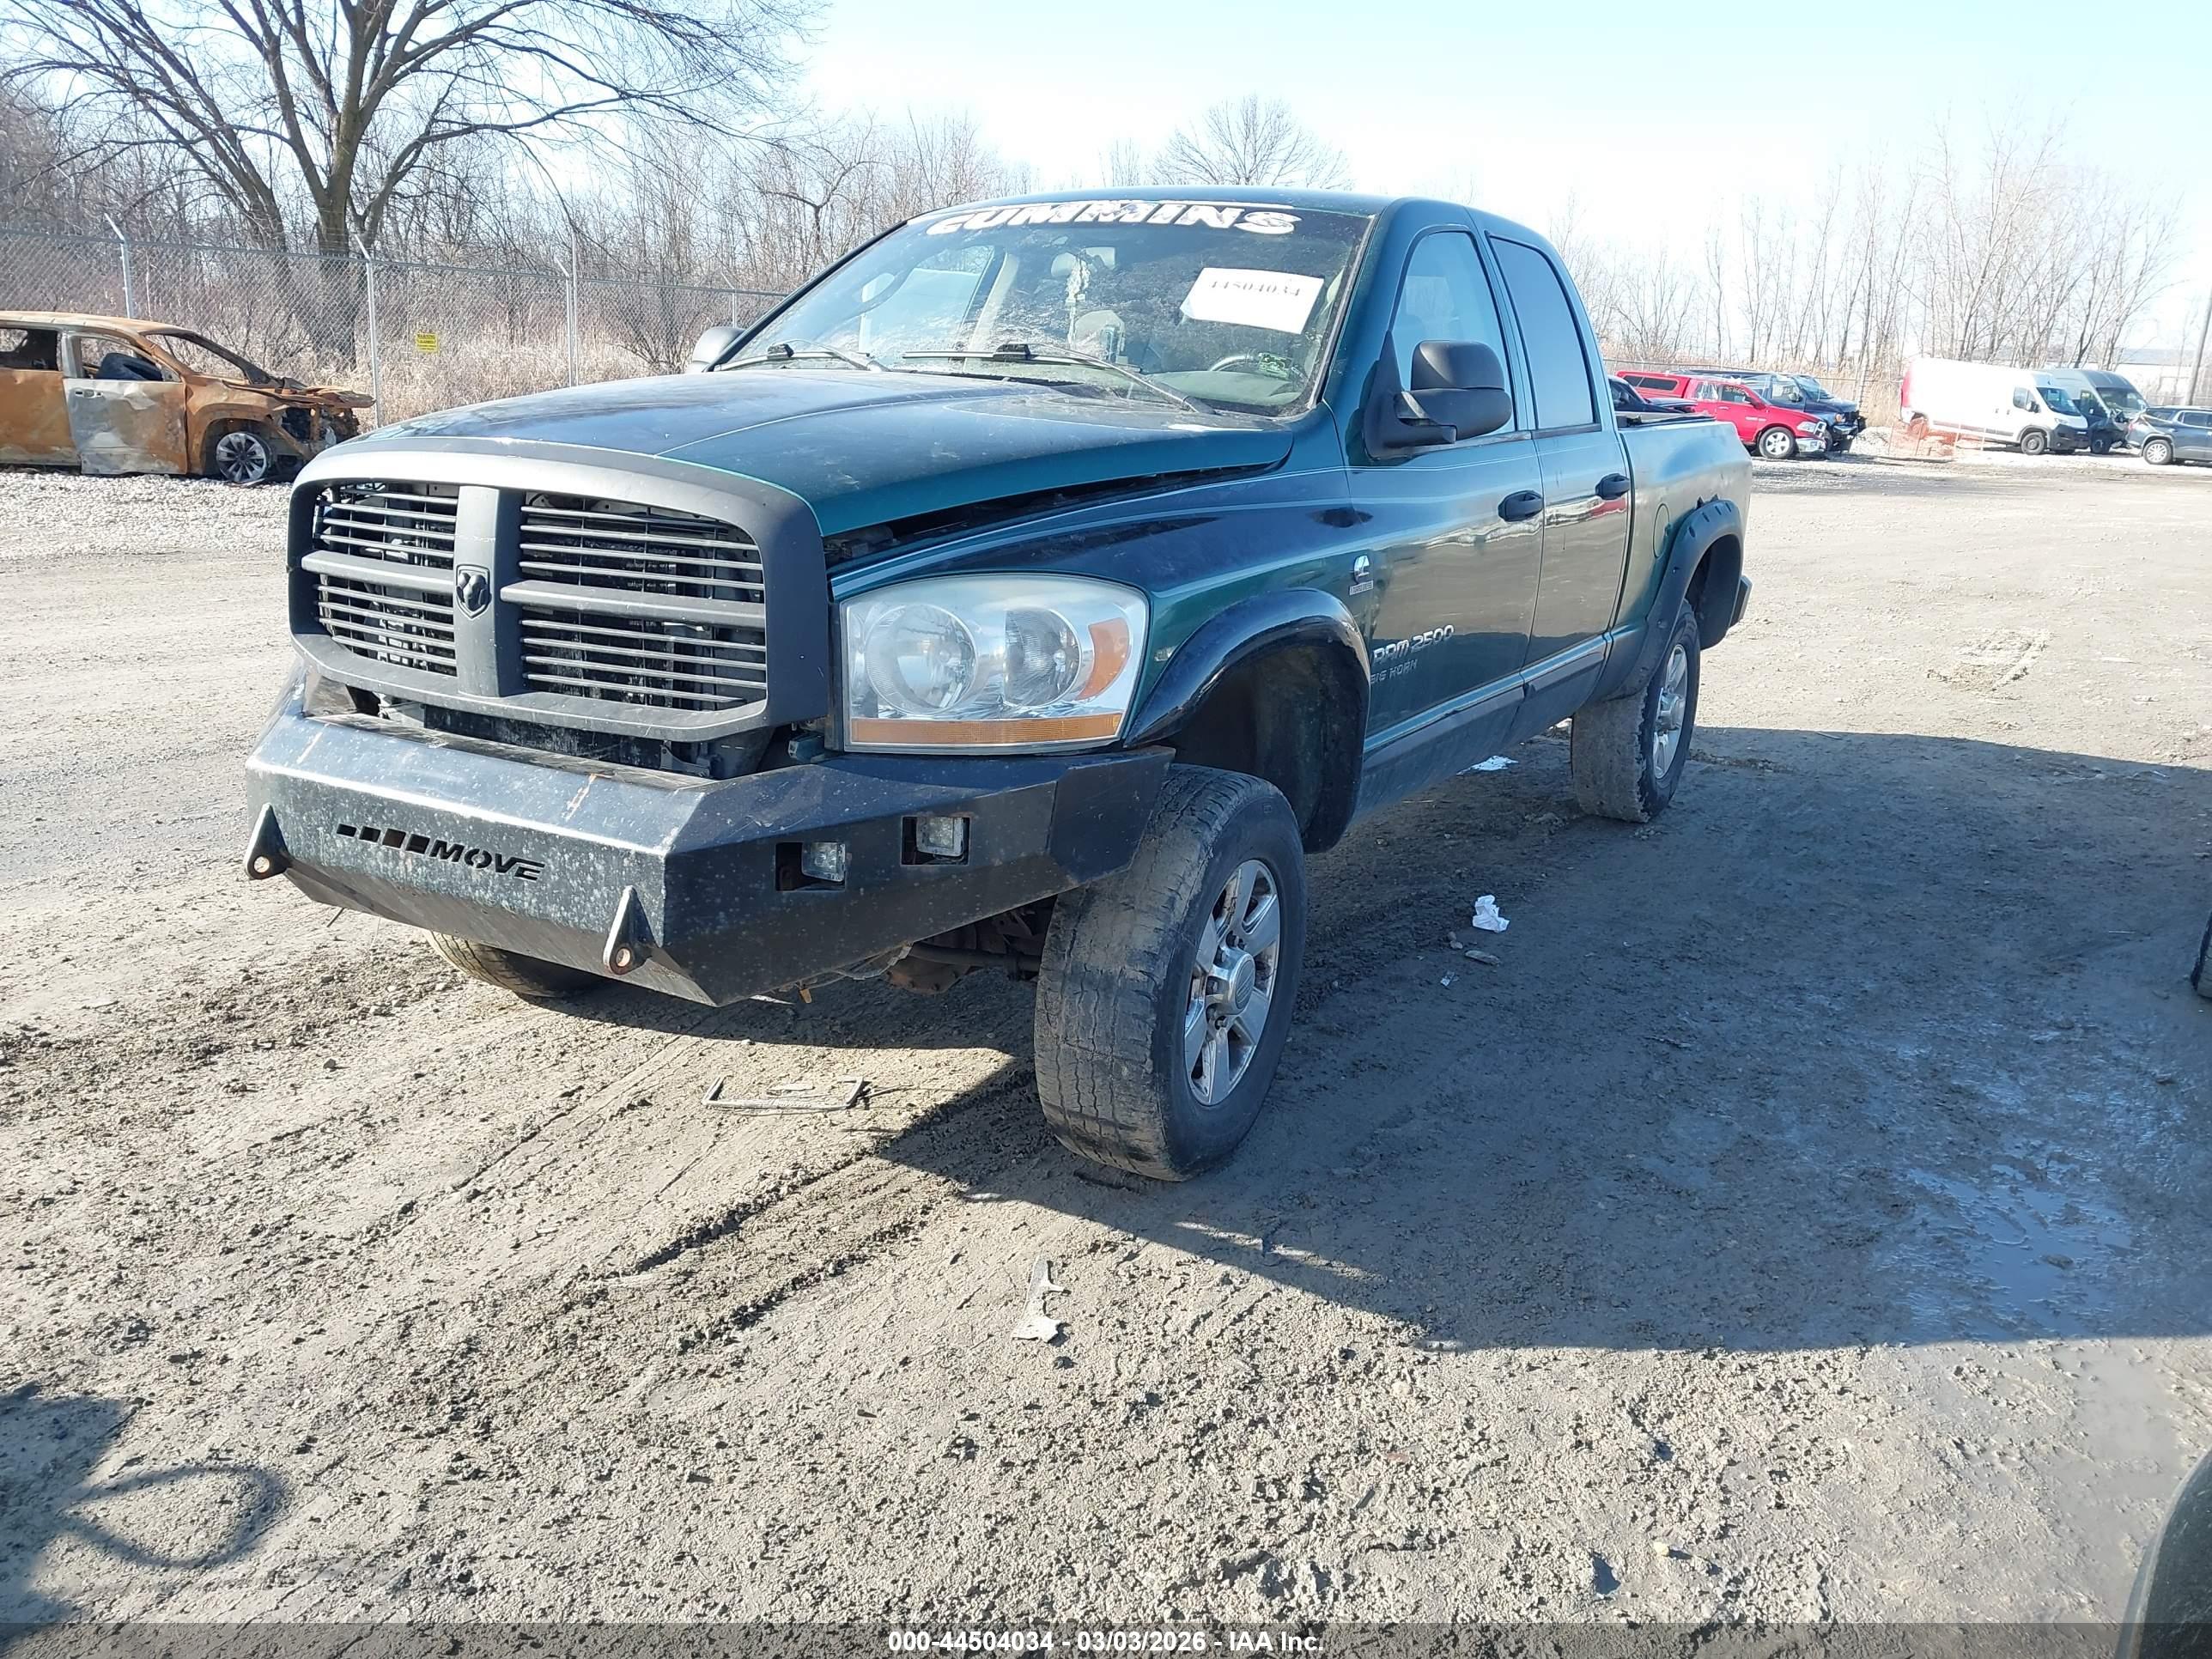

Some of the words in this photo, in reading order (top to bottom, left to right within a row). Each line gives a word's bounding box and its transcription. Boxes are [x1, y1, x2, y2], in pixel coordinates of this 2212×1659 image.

[926, 202, 1304, 234] CUMMINS
[1373, 639, 1410, 664] RAM
[1410, 625, 1455, 653] 2500
[1389, 659, 1418, 679] HORN
[429, 839, 546, 881] MOVE
